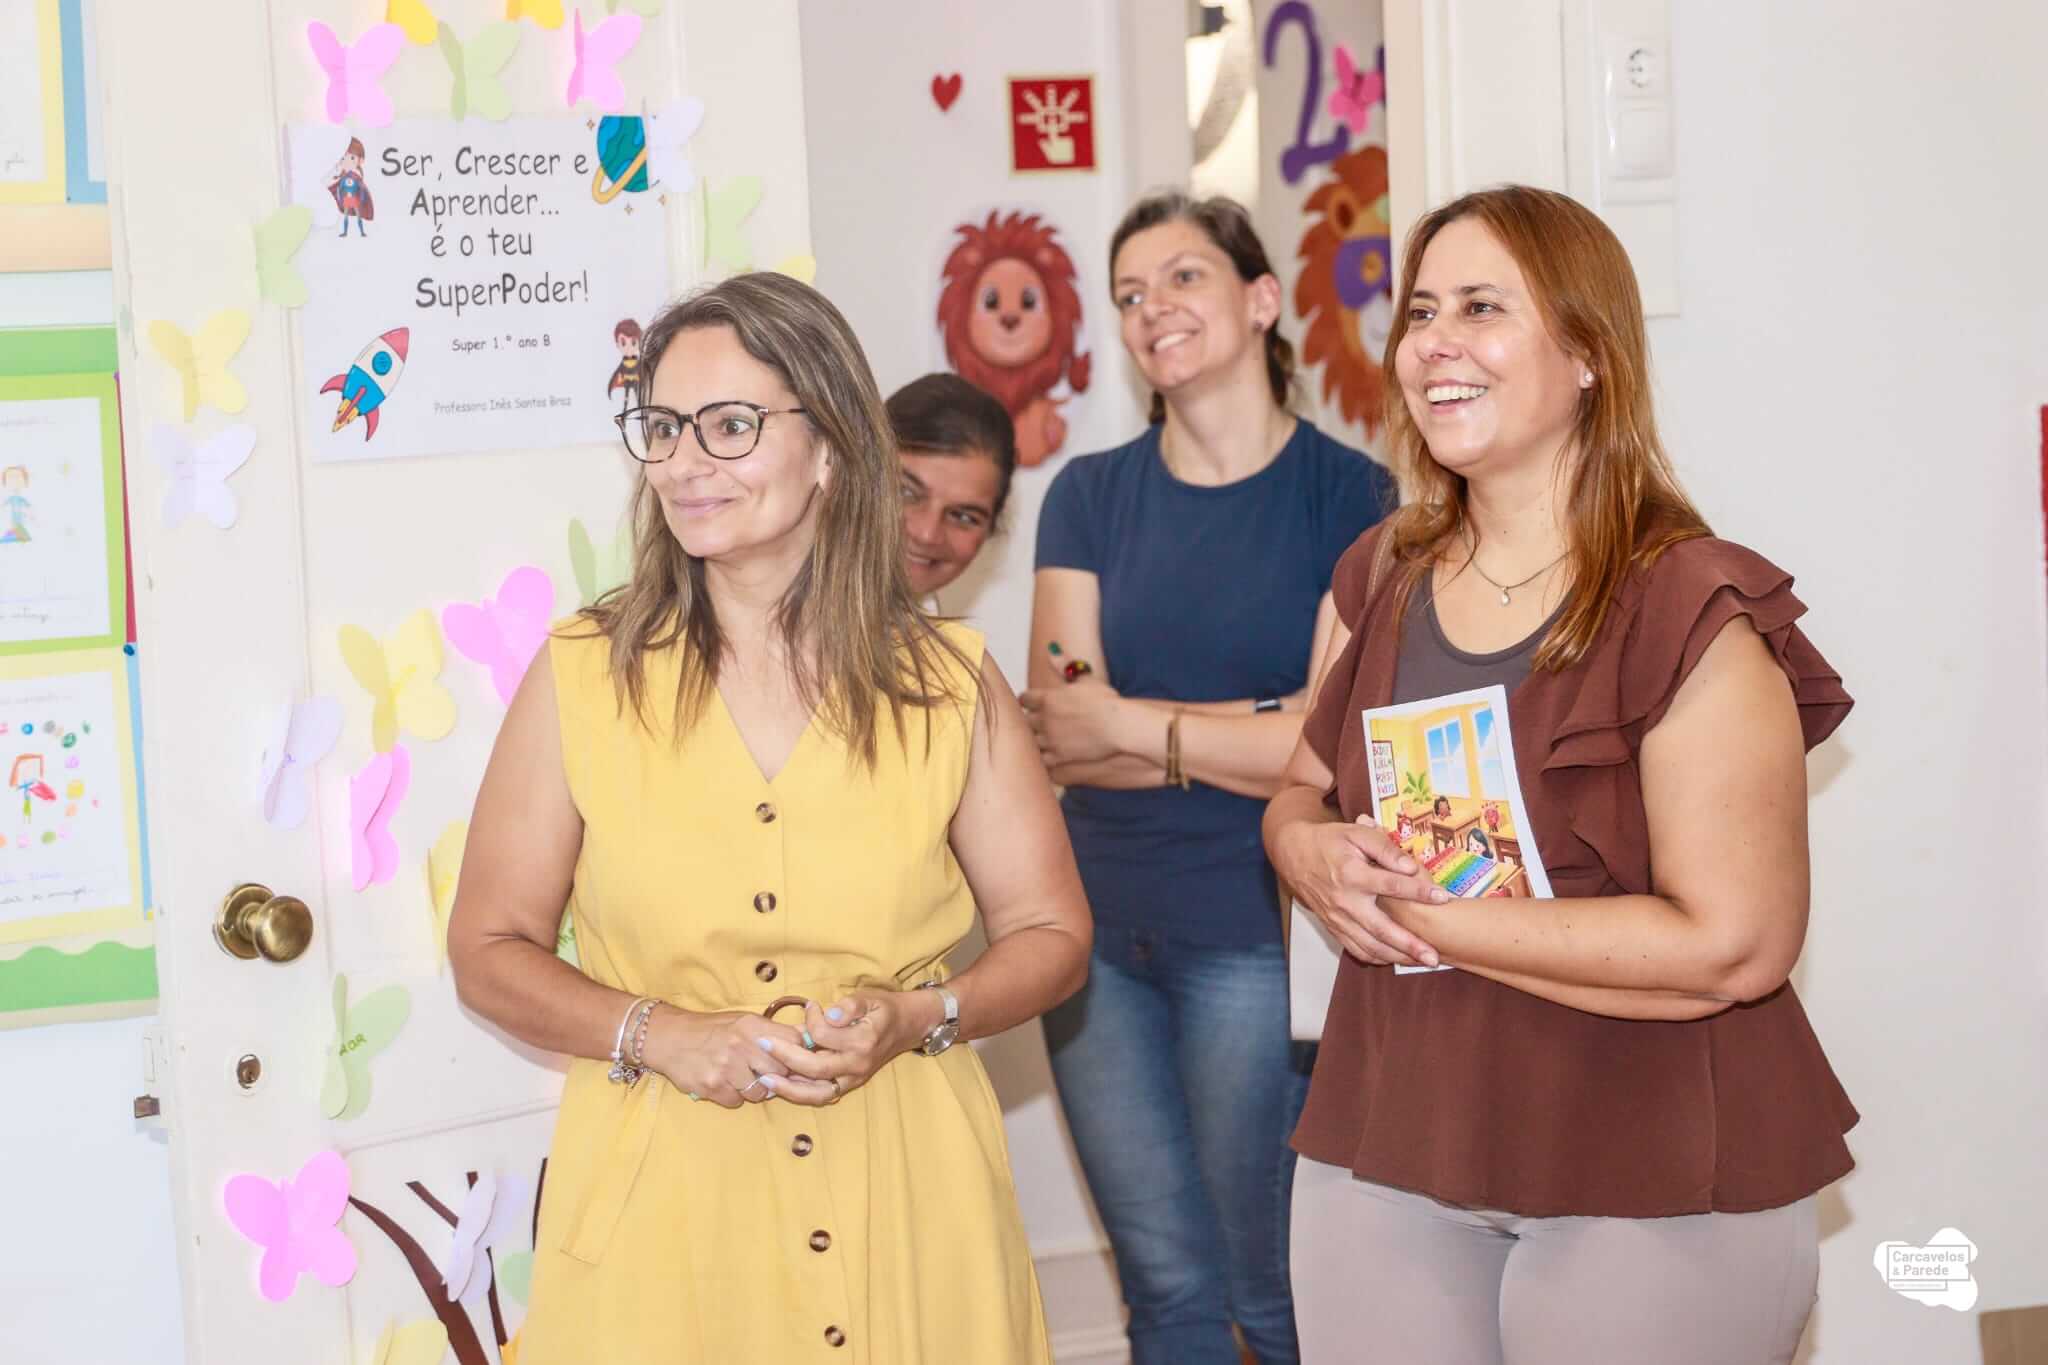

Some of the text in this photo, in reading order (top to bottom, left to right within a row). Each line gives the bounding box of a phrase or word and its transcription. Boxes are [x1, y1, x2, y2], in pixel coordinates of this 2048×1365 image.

[380, 145, 589, 181] Ser, Crescer e
[410, 183, 560, 226] Aprender...
[430, 222, 532, 257] é o teu
[415, 269, 588, 316] SuperPoder!
[452, 338, 486, 355] Super
[518, 338, 538, 348] ano
[543, 333, 551, 347] B
